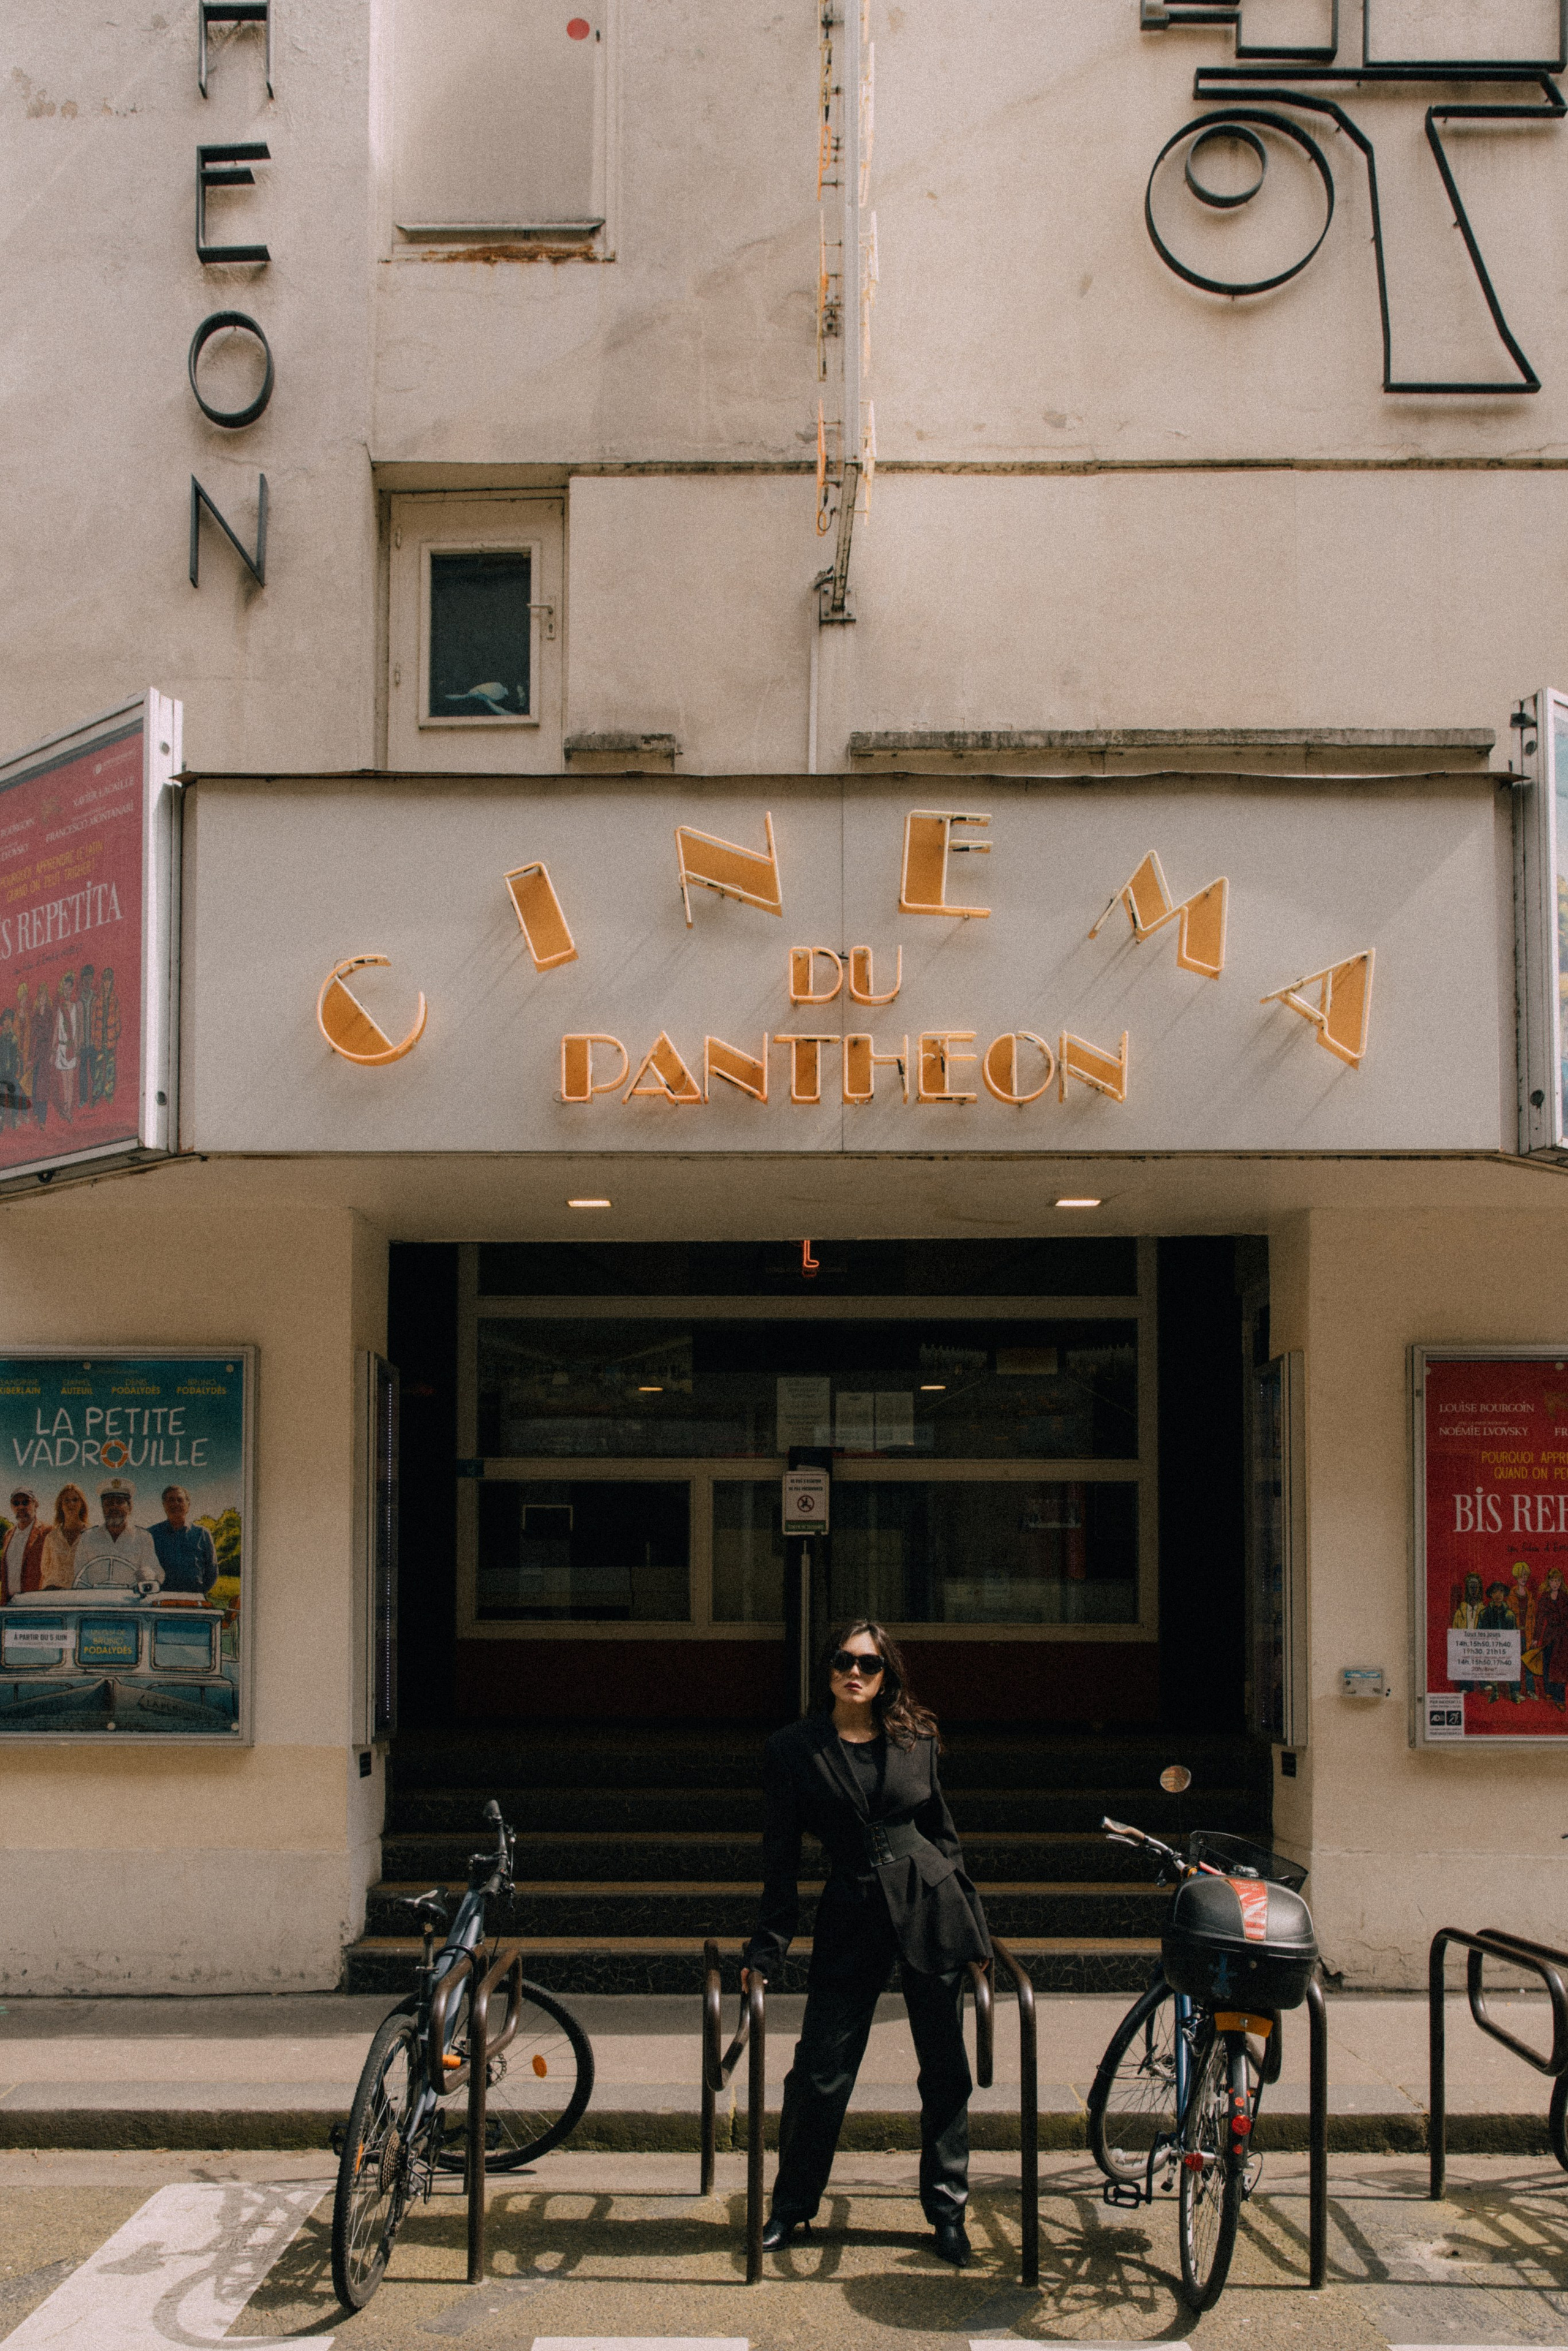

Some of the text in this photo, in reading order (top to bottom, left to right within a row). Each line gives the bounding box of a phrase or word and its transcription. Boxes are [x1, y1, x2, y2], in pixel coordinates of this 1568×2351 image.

[317, 809, 1376, 1070] CINEMA
[788, 945, 903, 1006] DU
[559, 1029, 1129, 1106] PANTHEON
[36, 1406, 186, 1436] LA PETITE
[1483, 1427, 1529, 1436] LVOVSKY
[13, 1438, 209, 1468] VADROUILLE
[1481, 1451, 1534, 1464] POURQUOI
[1494, 1466, 1528, 1480] QUAND
[1532, 1466, 1548, 1479] ON
